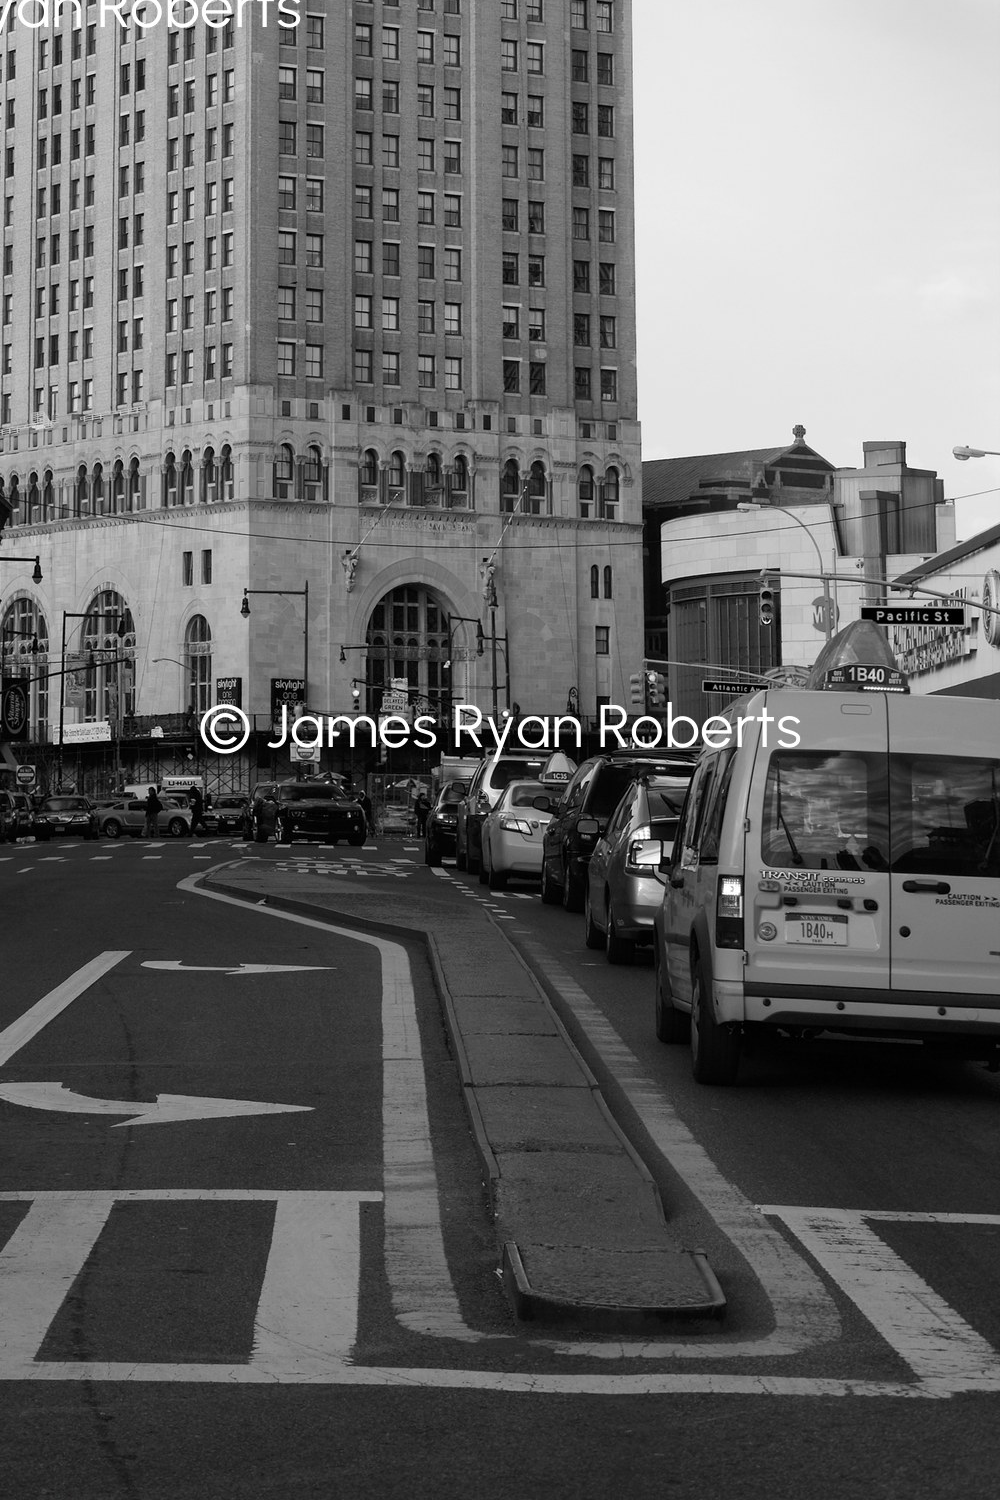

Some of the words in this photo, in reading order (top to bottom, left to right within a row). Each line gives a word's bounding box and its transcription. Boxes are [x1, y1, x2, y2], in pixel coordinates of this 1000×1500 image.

[876, 611, 929, 621] Pacific
[934, 611, 949, 621] St
[848, 666, 885, 683] 1B40
[275, 680, 305, 691] skylight
[712, 684, 748, 692] Atlantic
[282, 691, 298, 699] one
[760, 870, 820, 881] TRANSIT
[822, 875, 866, 884] connect
[783, 885, 821, 893] PASSENGER
[822, 887, 849, 895] EXITING
[935, 898, 974, 906] PASSENGER
[947, 893, 981, 901] CAUTION
